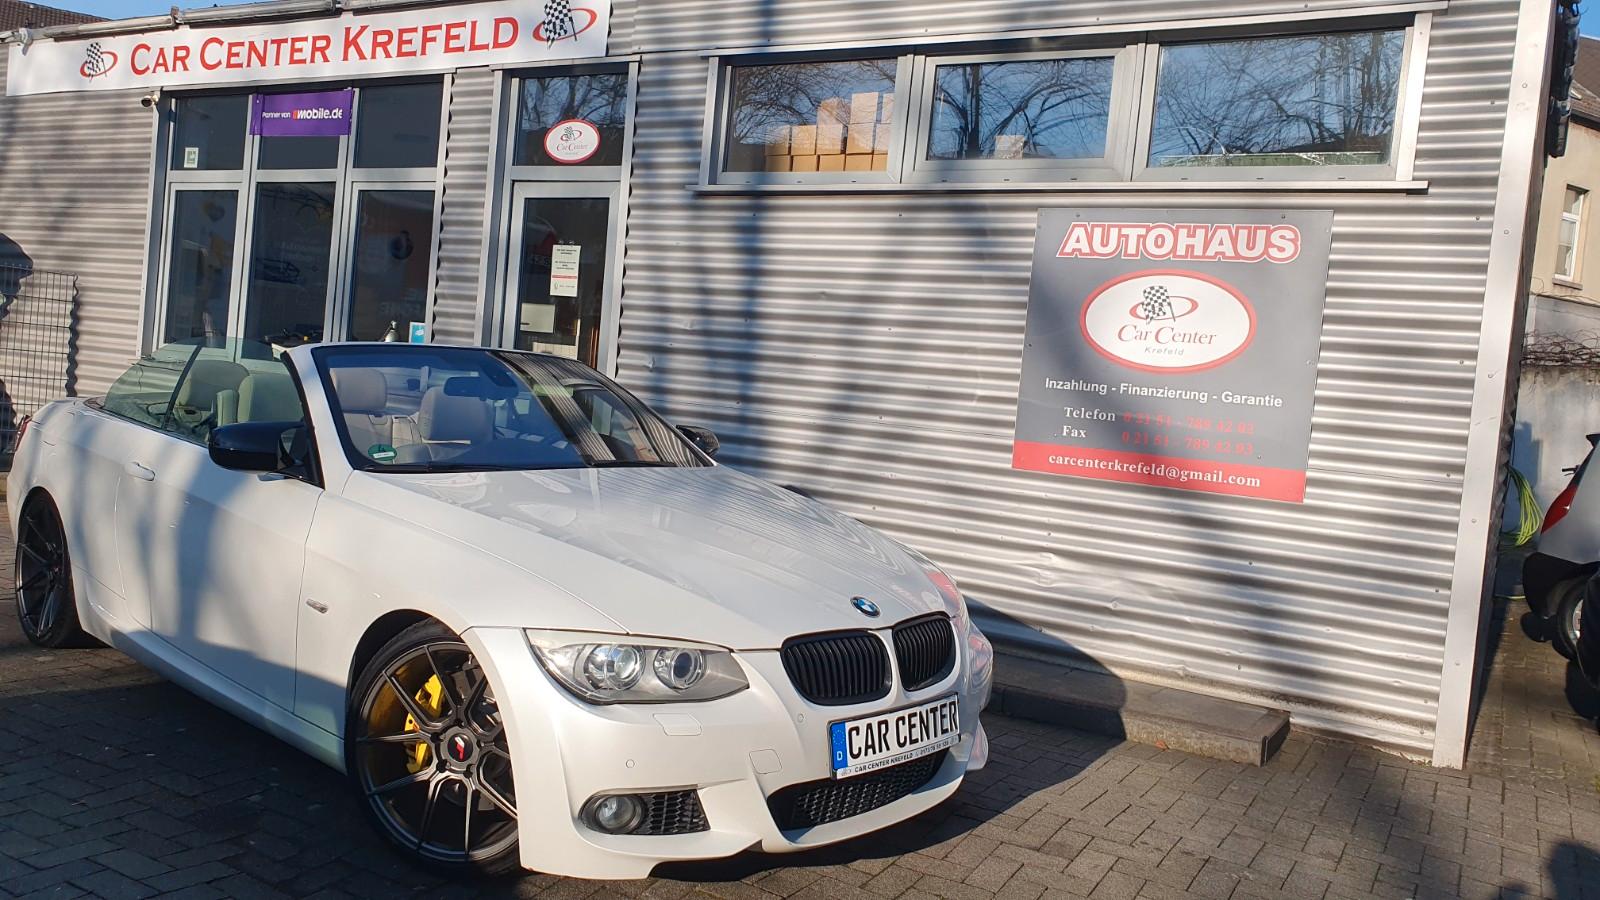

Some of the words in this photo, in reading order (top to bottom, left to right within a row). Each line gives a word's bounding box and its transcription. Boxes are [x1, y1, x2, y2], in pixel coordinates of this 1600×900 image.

[130, 43, 191, 76] CAR
[199, 36, 331, 71] CENTER
[342, 16, 519, 62] KREFELD
[1056, 222, 1301, 264] AUTOHAUS
[1117, 324, 1152, 342] Car
[1154, 326, 1217, 345] Center
[1144, 346, 1185, 356] Krefeld
[1045, 378, 1108, 396] Inzahlung
[1119, 383, 1208, 404] Finanzierung
[1221, 391, 1283, 408] Garantie
[1064, 406, 1117, 422] Telefon
[1062, 425, 1087, 439] Fax
[1048, 454, 1261, 488] carcenterkrefeld@gmail.com
[848, 719, 891, 759] CAR
[895, 700, 959, 748] CENTER
[836, 750, 843, 761] D
[854, 765, 867, 773] CAR
[867, 758, 890, 770] CENTER
[890, 752, 913, 765] KREFELD
